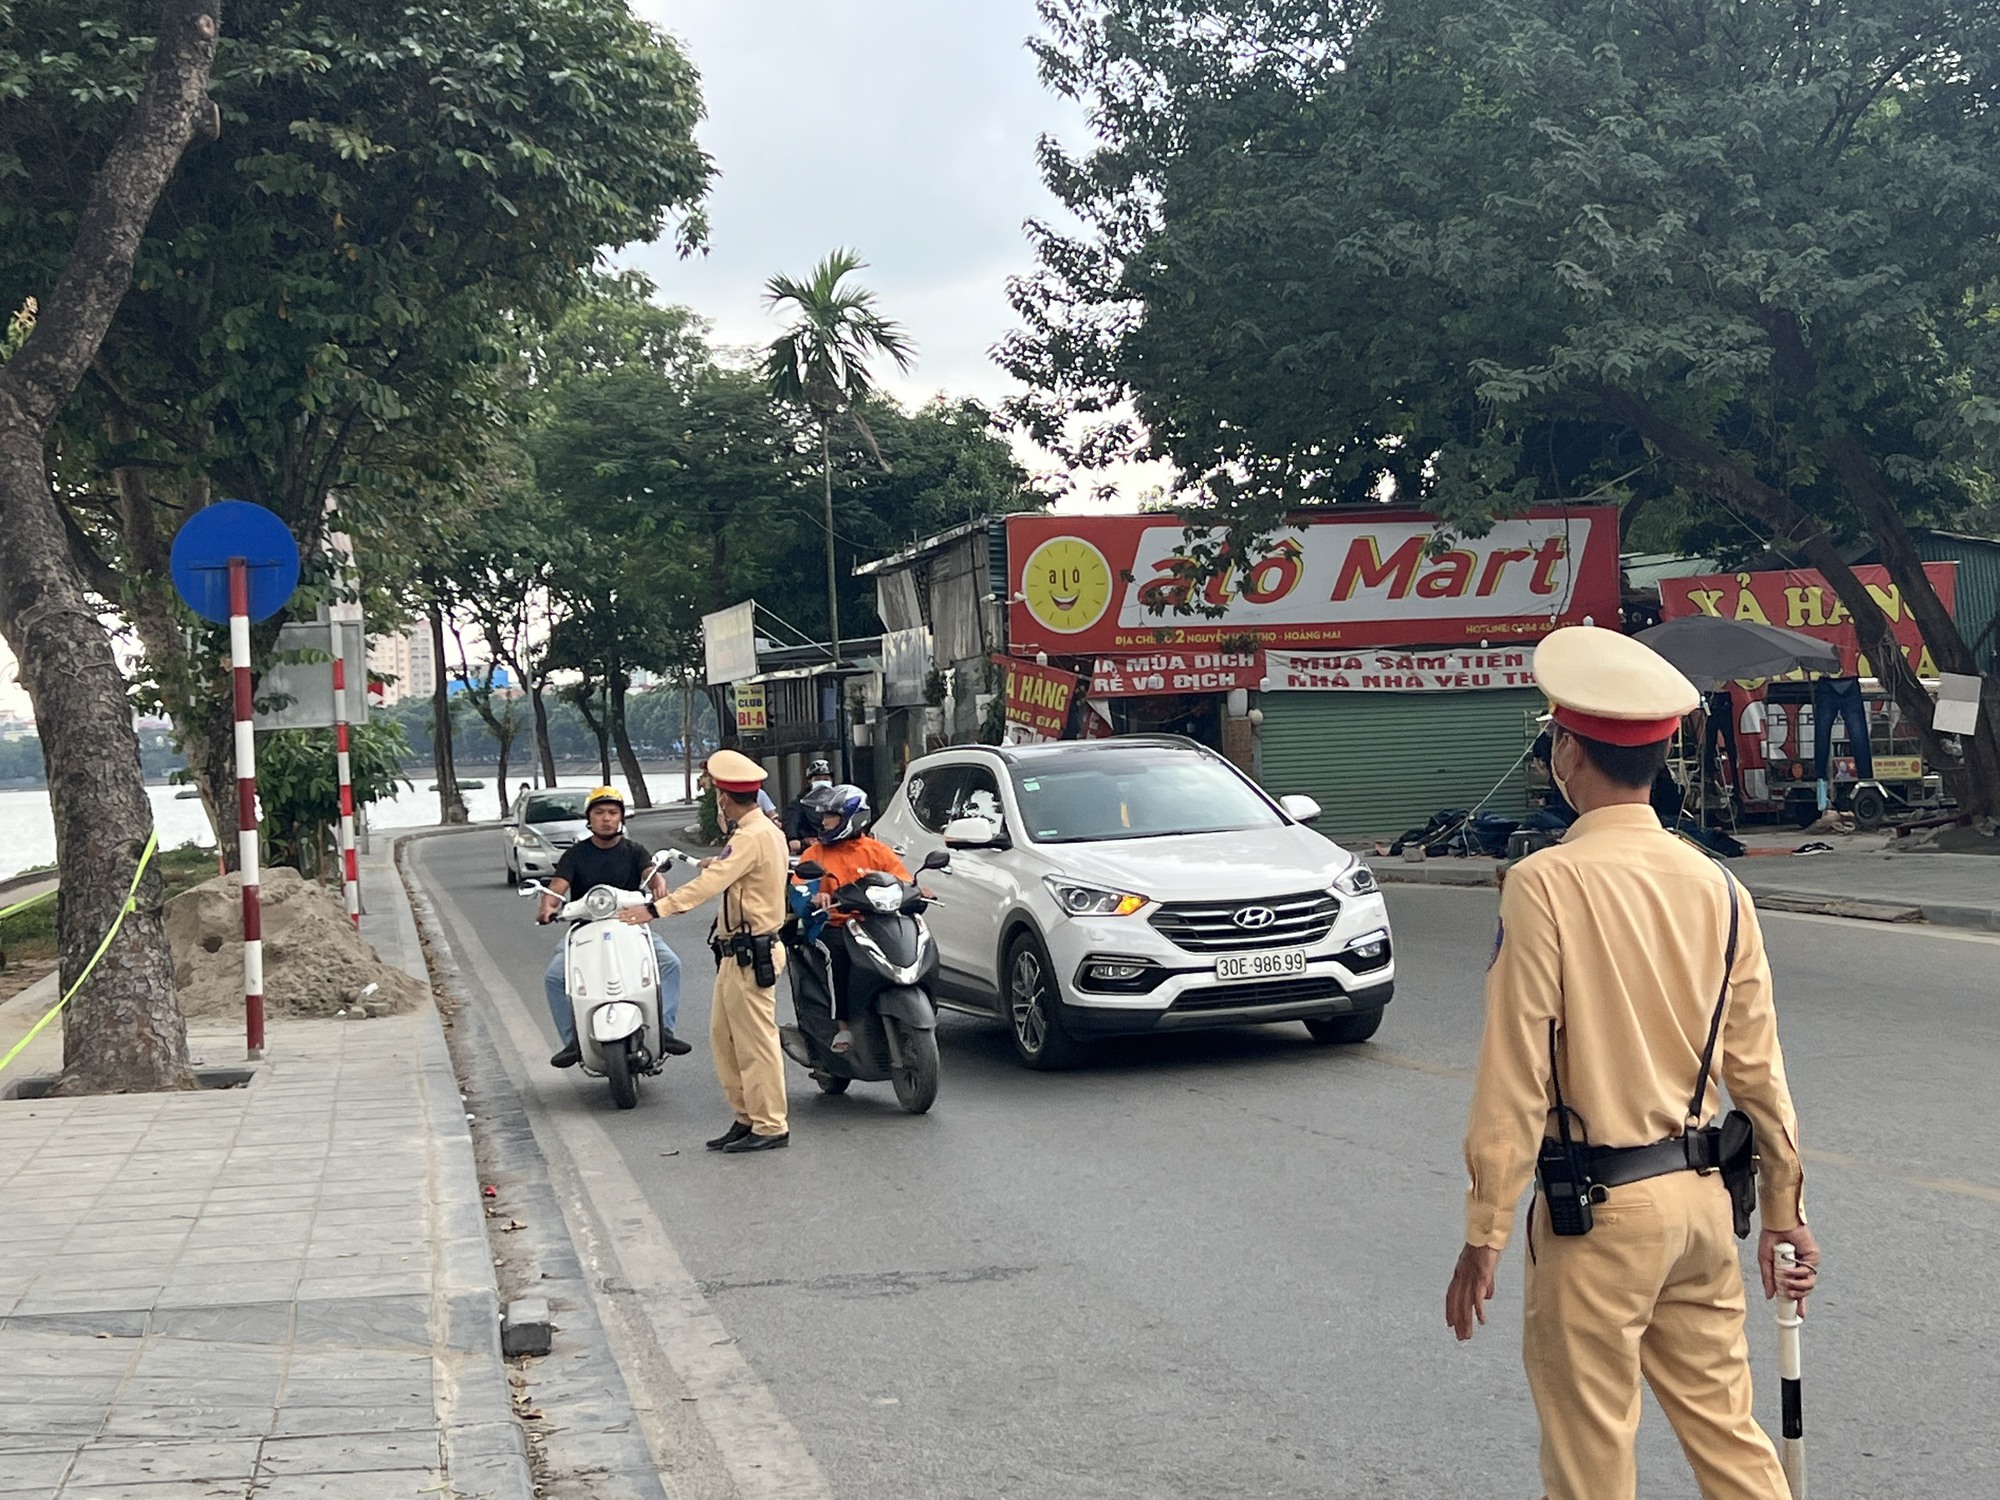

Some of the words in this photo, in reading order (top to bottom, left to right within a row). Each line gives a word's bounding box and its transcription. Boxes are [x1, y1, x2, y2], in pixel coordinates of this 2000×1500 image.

[1329, 533, 1566, 602] Mart
[1174, 630, 1186, 644] 2
[1323, 630, 1342, 640] MAI
[1195, 653, 1254, 671] DỊCH
[1020, 672, 1069, 712] HÀNG
[1220, 953, 1302, 976] 30E-986.99
